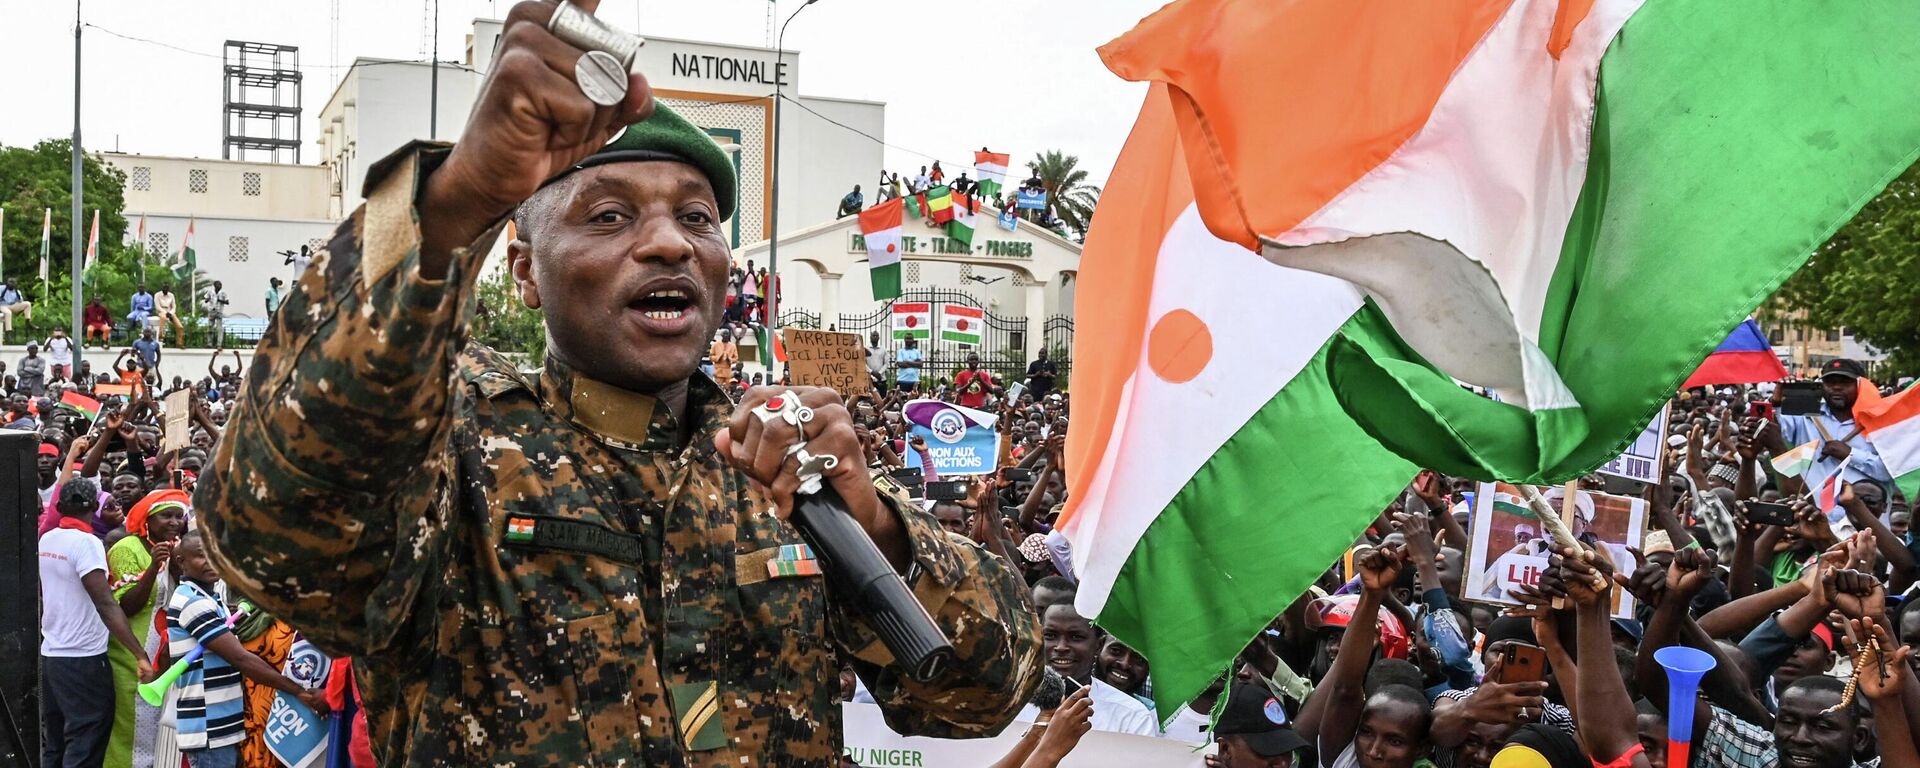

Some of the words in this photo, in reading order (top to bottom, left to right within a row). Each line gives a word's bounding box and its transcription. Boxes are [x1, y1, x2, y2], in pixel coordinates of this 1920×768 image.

[672, 52, 788, 86] NATIONALE
[790, 350, 812, 361] ICI
[816, 362, 849, 376] VIVE
[928, 447, 952, 458] NON
[953, 446, 976, 457] AUX
[870, 749, 923, 767] NIGER
